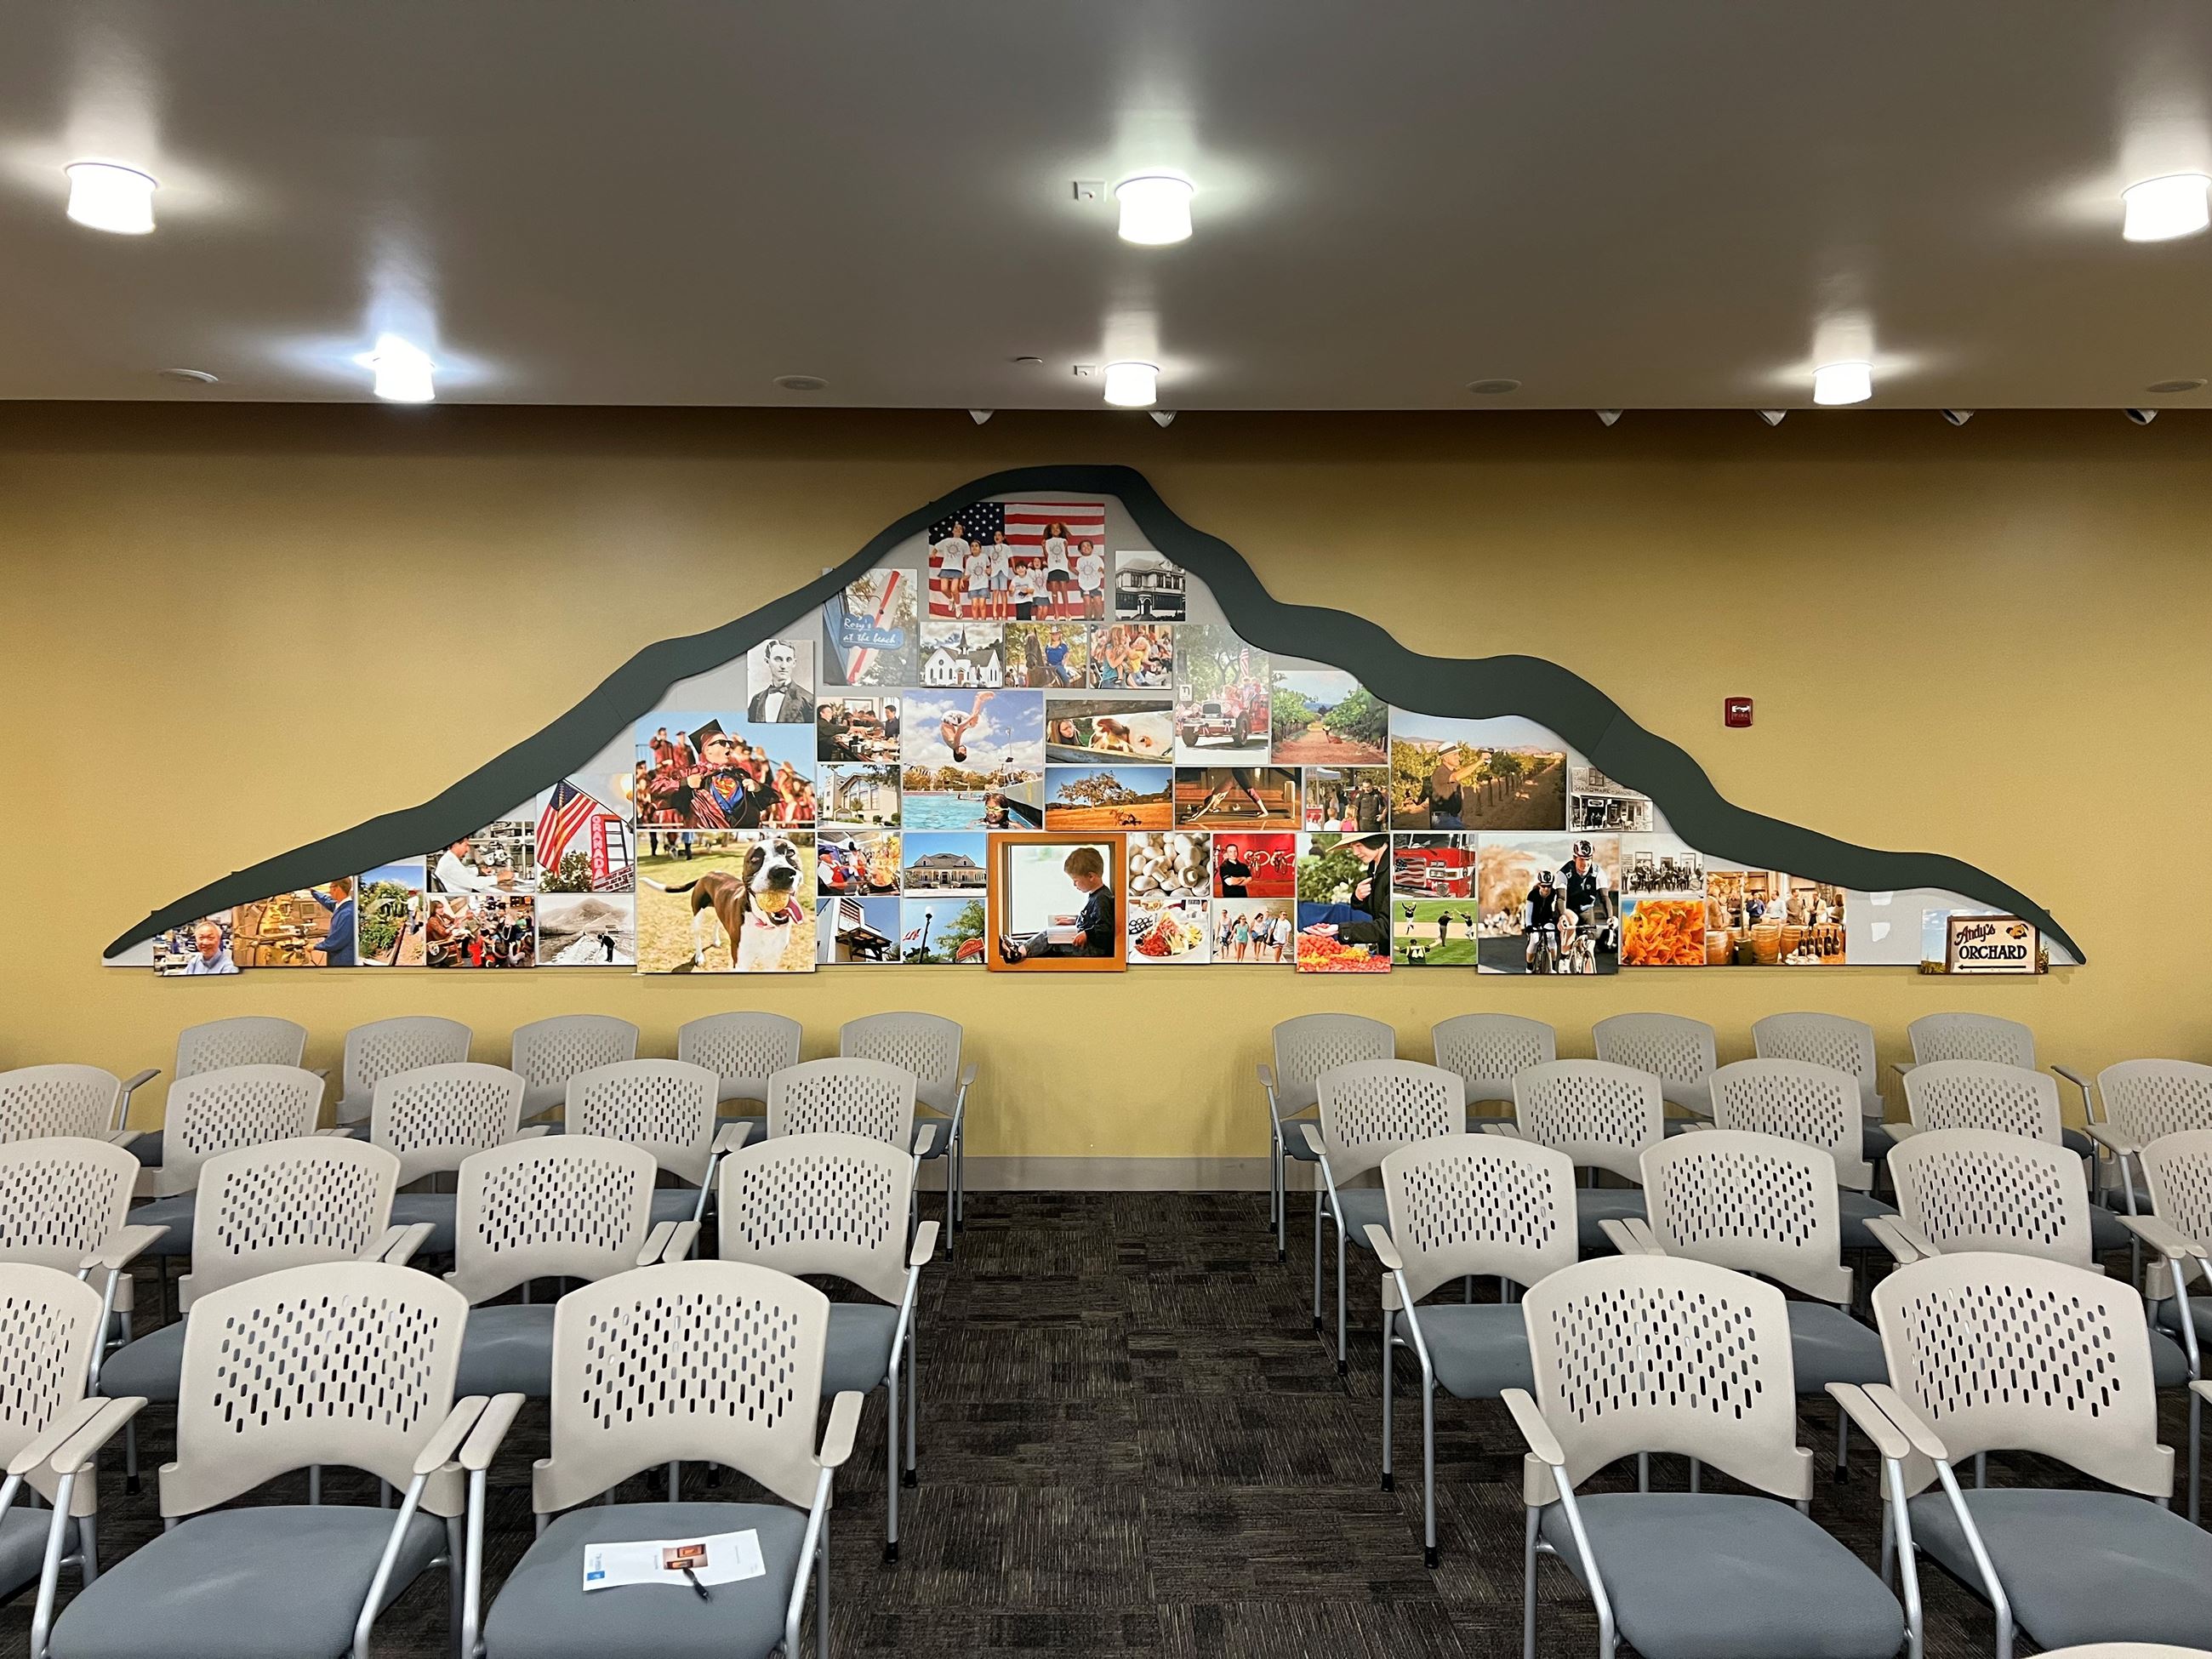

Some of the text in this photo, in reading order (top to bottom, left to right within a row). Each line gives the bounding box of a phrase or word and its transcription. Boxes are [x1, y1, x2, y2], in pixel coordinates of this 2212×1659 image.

[844, 618, 871, 632] Rosy's
[858, 632, 869, 641] the
[873, 632, 896, 643] beach
[591, 815, 605, 880] GRANADA
[1954, 923, 1996, 946] Andy's
[1958, 945, 2027, 960] ORCHARD
